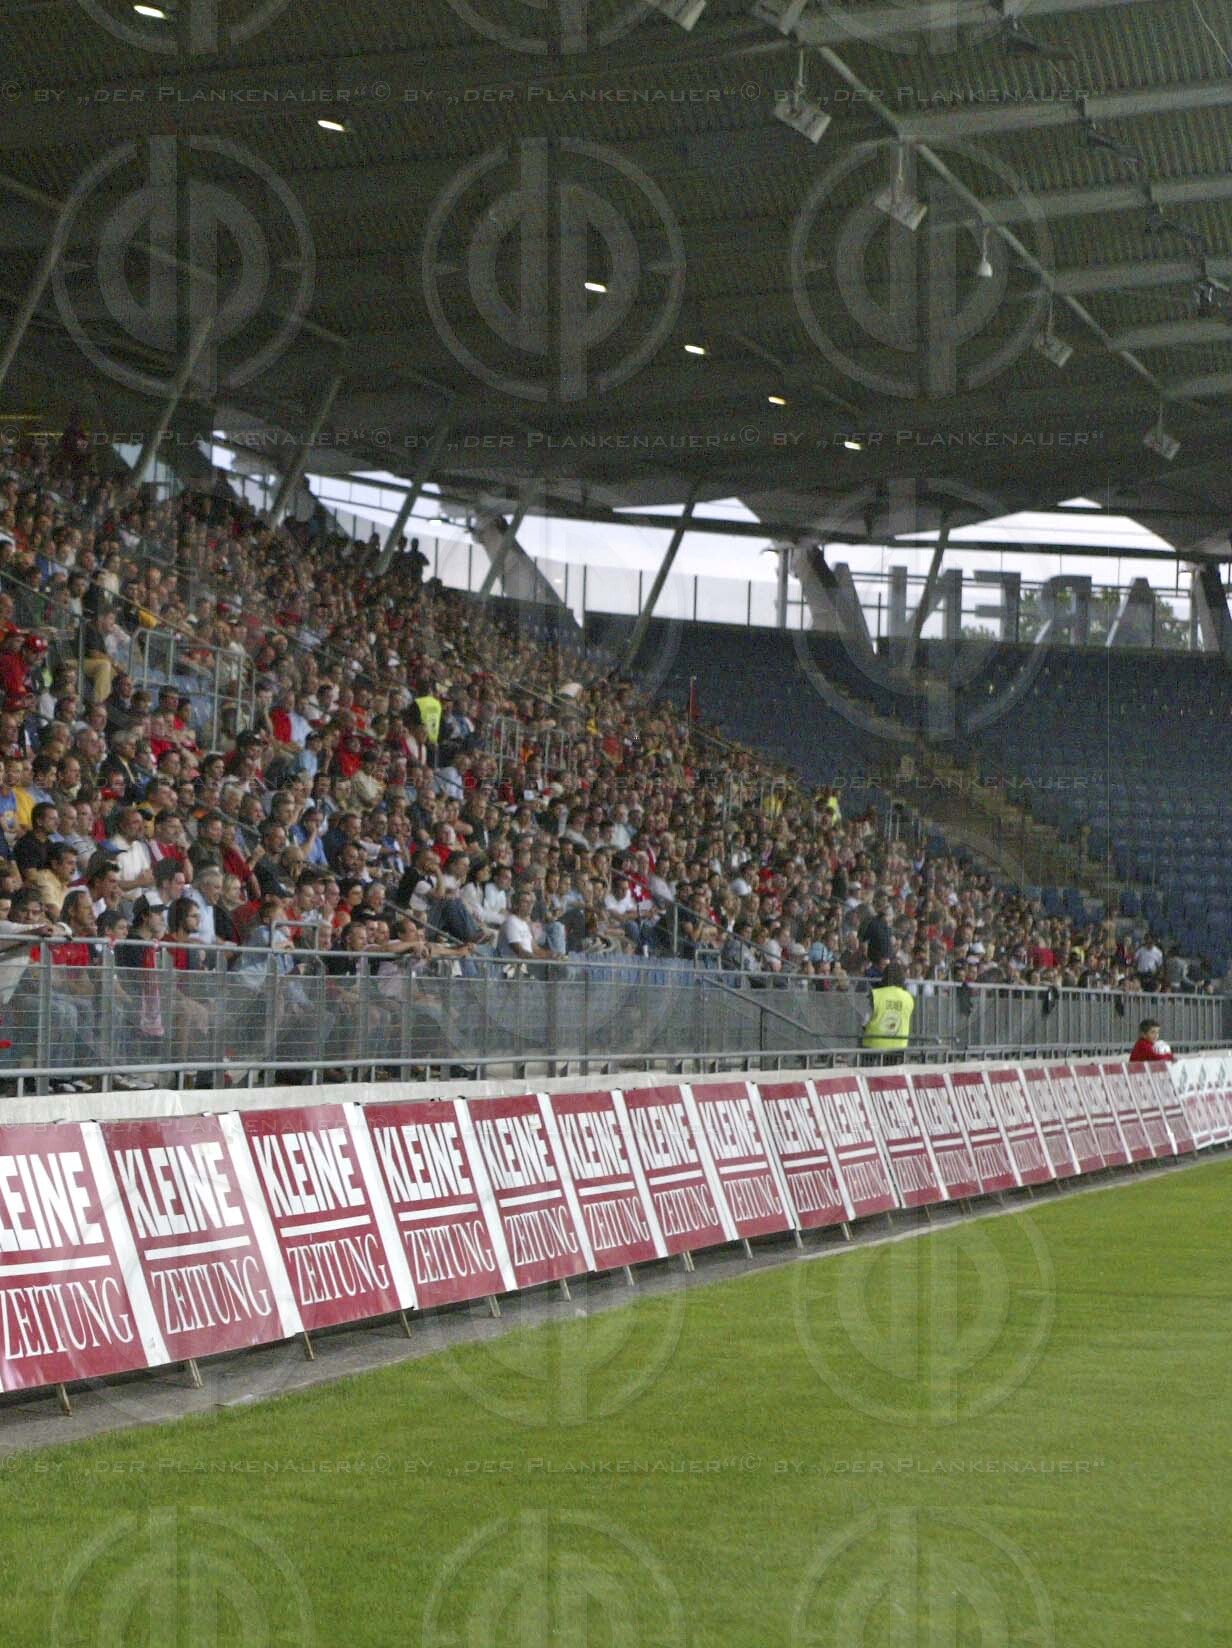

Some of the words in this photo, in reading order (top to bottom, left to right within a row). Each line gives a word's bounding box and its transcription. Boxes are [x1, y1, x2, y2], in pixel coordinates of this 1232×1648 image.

[557, 1110, 629, 1180] KLEINE
[629, 1103, 698, 1170] KLEINE
[698, 1099, 765, 1160] KLEINE
[764, 1097, 824, 1154] KLEINE
[820, 1091, 873, 1146] KLEINE
[252, 1128, 365, 1217] KLEINE
[373, 1121, 473, 1203] KLEINE
[475, 1113, 557, 1190] KLEINE
[113, 1142, 244, 1238] KLEINE
[653, 1183, 719, 1236] ZEITUNG
[723, 1175, 782, 1221] ZEITUNG
[787, 1168, 842, 1212] ZEITUNG
[404, 1220, 495, 1284] ZEITUNG
[504, 1205, 578, 1266] ZEITUNG
[583, 1196, 650, 1250] ZEITUNG
[151, 1255, 272, 1335] ZEITUNG
[286, 1233, 390, 1306] ZEITUNG
